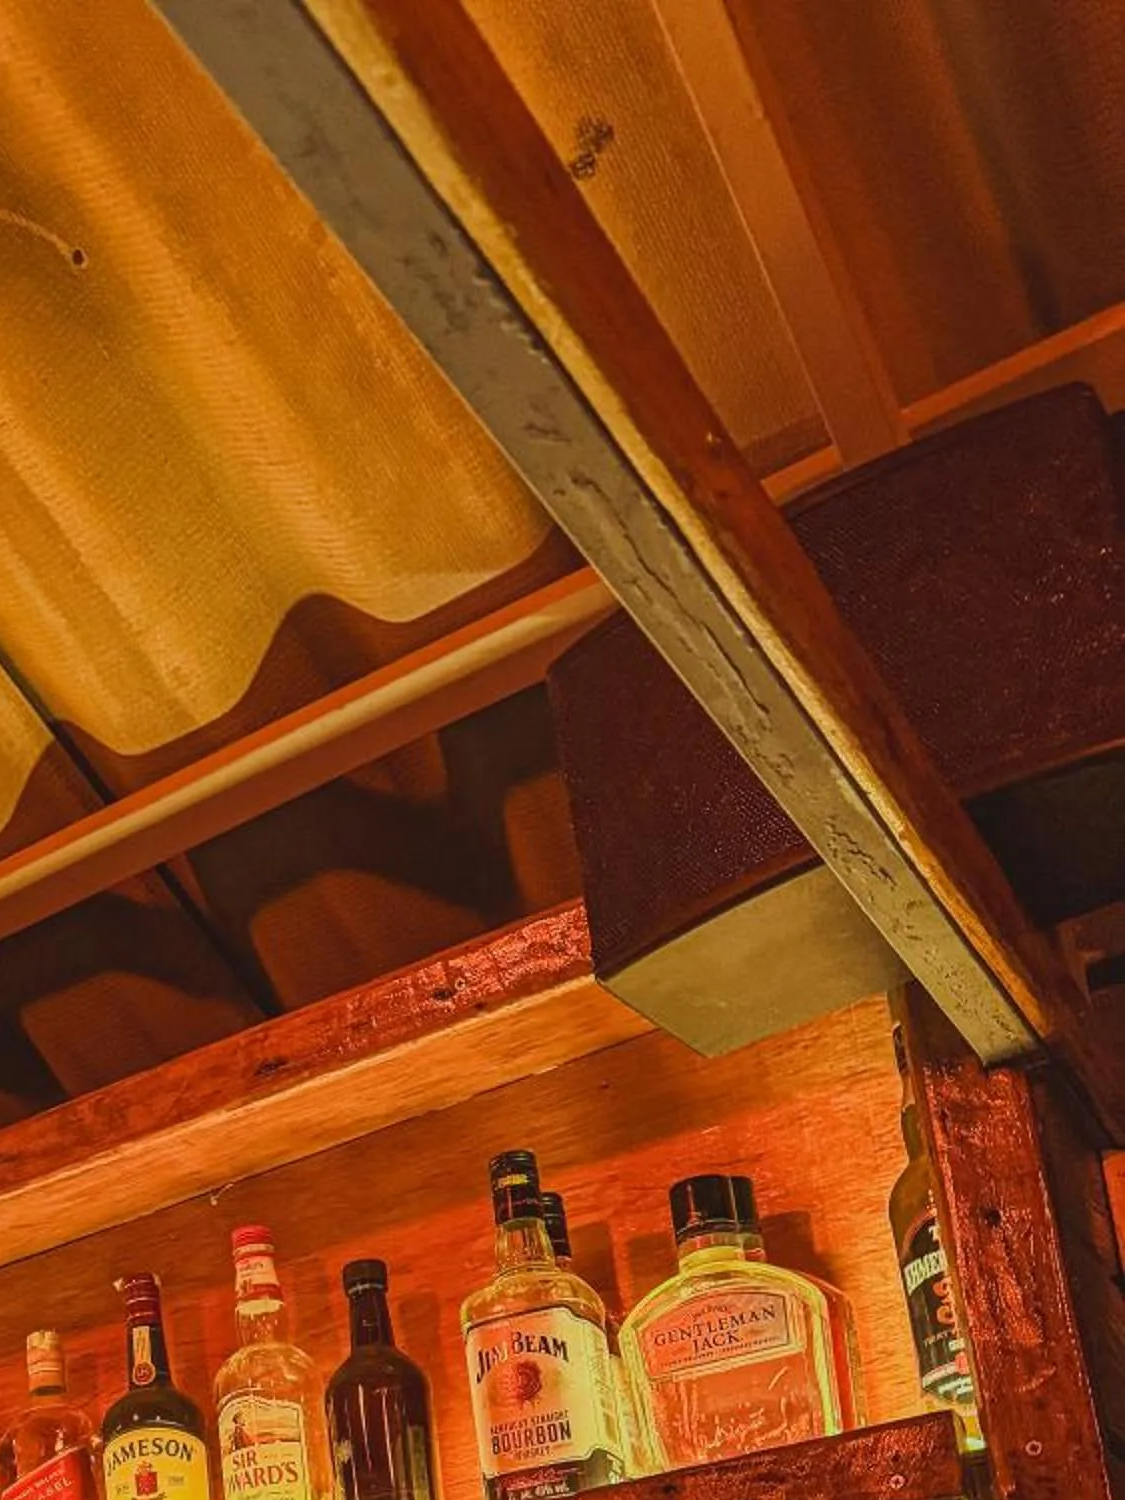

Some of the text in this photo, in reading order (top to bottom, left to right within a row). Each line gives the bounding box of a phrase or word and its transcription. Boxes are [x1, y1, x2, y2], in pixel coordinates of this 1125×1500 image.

[654, 1304, 776, 1347] GENTLEMAN
[512, 1331, 569, 1363] BEAM
[491, 1419, 572, 1455] BOURBON
[106, 1437, 194, 1477] JAMESON
[232, 1447, 258, 1471] SIR
